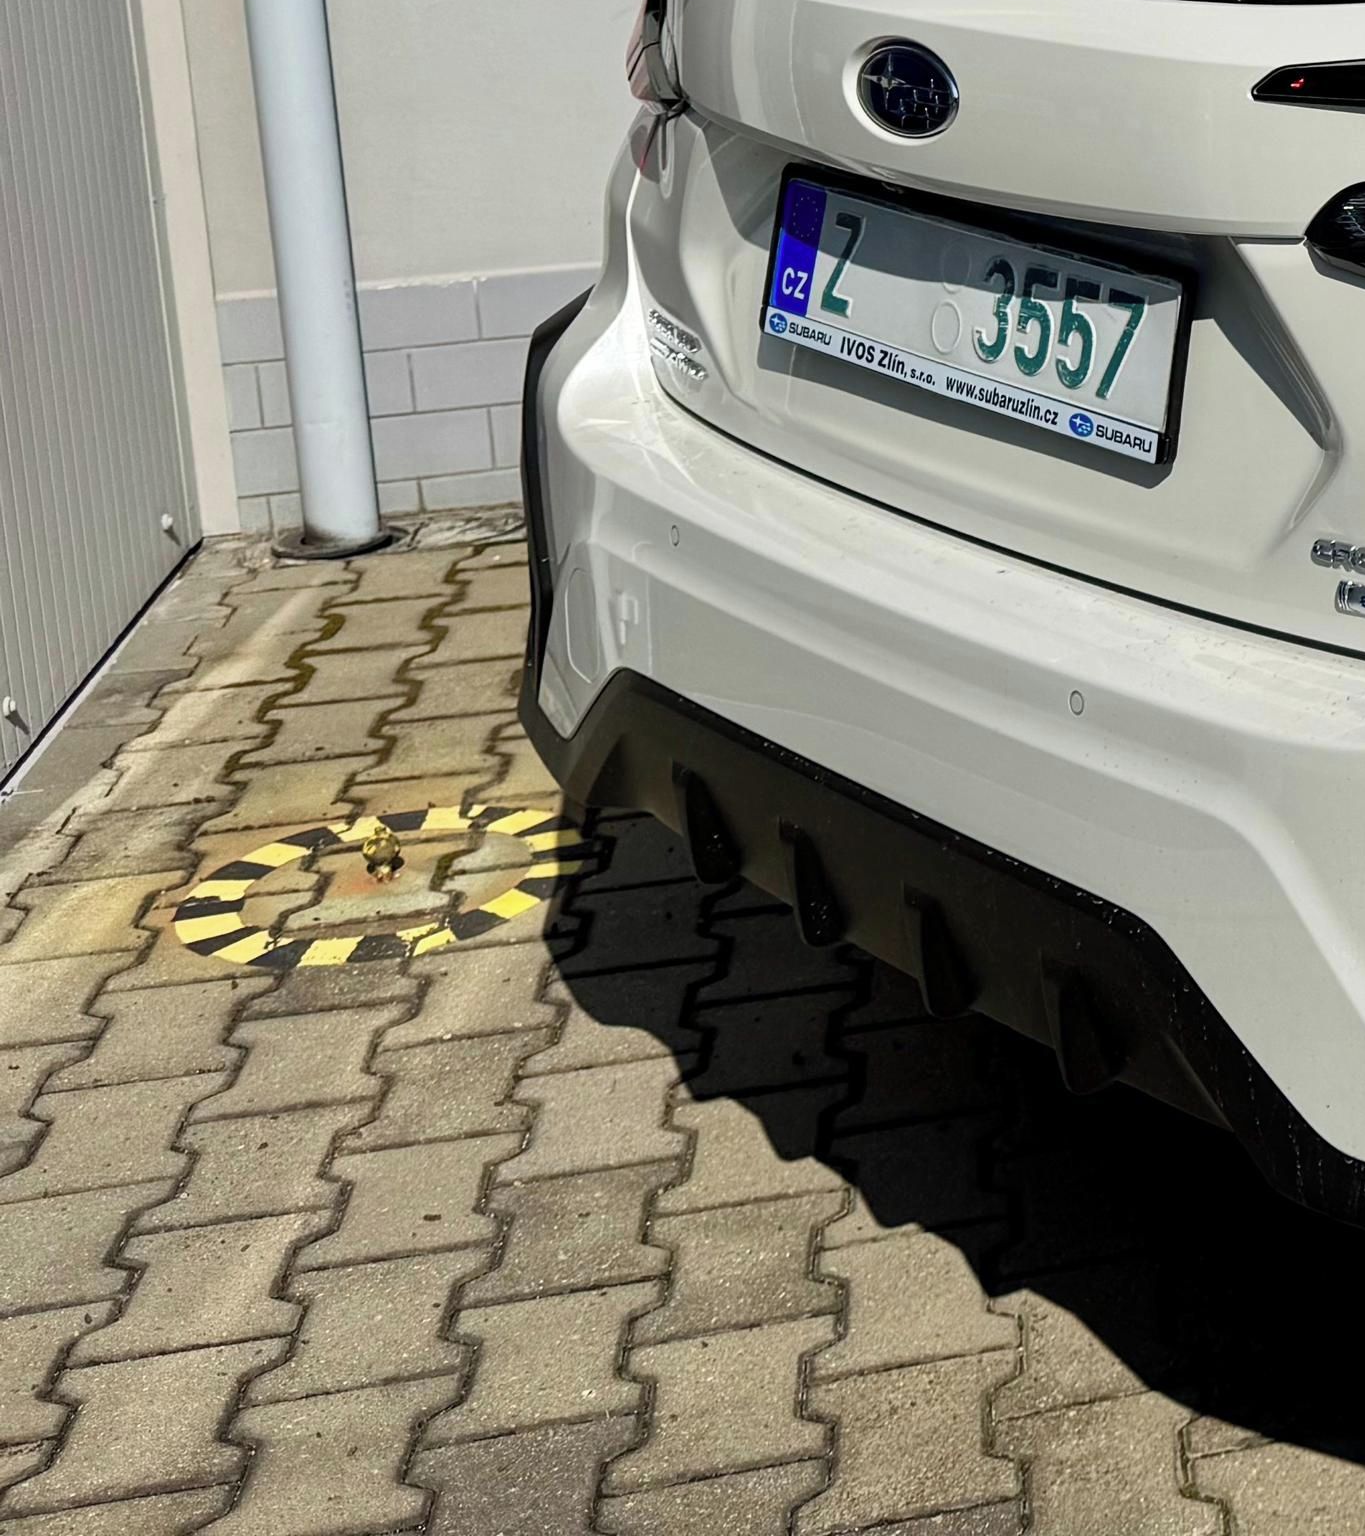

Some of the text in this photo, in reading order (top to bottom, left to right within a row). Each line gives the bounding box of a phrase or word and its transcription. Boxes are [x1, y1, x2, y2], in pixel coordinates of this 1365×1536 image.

[781, 267, 809, 300] CZ
[820, 212, 1150, 401] Z 3557
[788, 322, 1153, 454] SUBARU IVOS Zlín, s.r.o. www.subaruzlin.cz SUBARU
